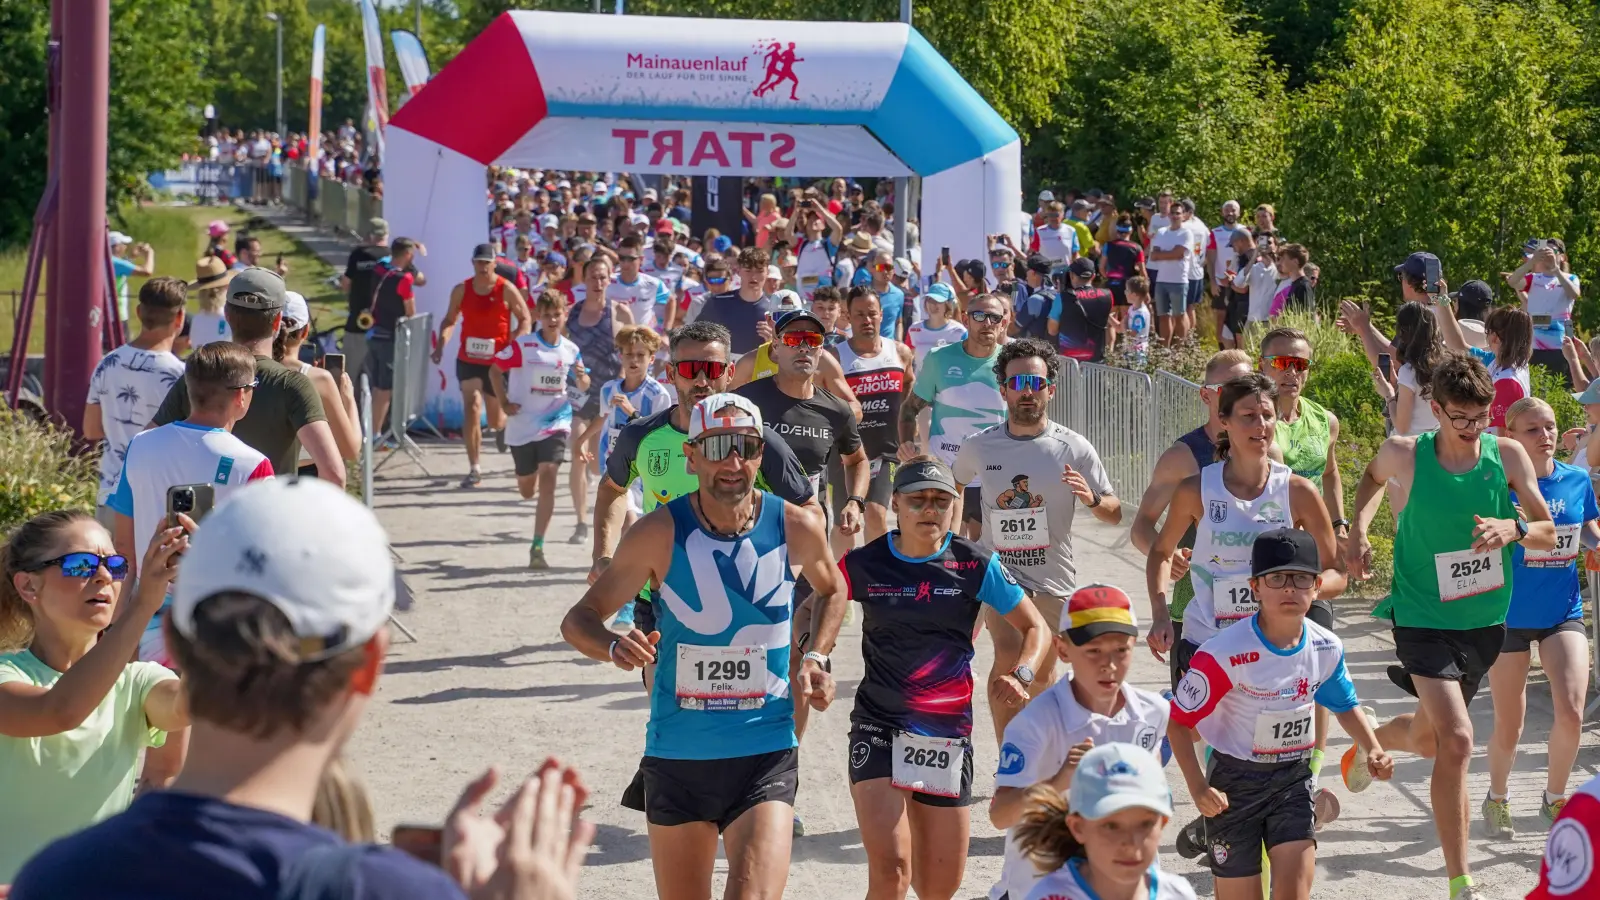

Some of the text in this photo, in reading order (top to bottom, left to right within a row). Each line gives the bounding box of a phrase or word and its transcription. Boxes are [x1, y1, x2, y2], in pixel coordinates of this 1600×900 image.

[626, 53, 749, 72] Mainauenlauf
[626, 71, 748, 83] DER LAUF FÜR DIE SINNE
[540, 375, 562, 385] 1069
[858, 372, 890, 383] TEAM
[1000, 518, 1036, 533] 2612
[1003, 533, 1034, 541] RICCARDO
[943, 560, 979, 571] CREW
[1450, 556, 1491, 579] 2524
[1457, 577, 1478, 590] ELIA
[933, 587, 963, 597] cep
[1229, 651, 1260, 667] NKD
[694, 660, 751, 681] 1299
[711, 682, 733, 691] Felix
[1280, 687, 1295, 696] 2025
[1272, 716, 1312, 739] 1257
[903, 746, 950, 769] 2629
